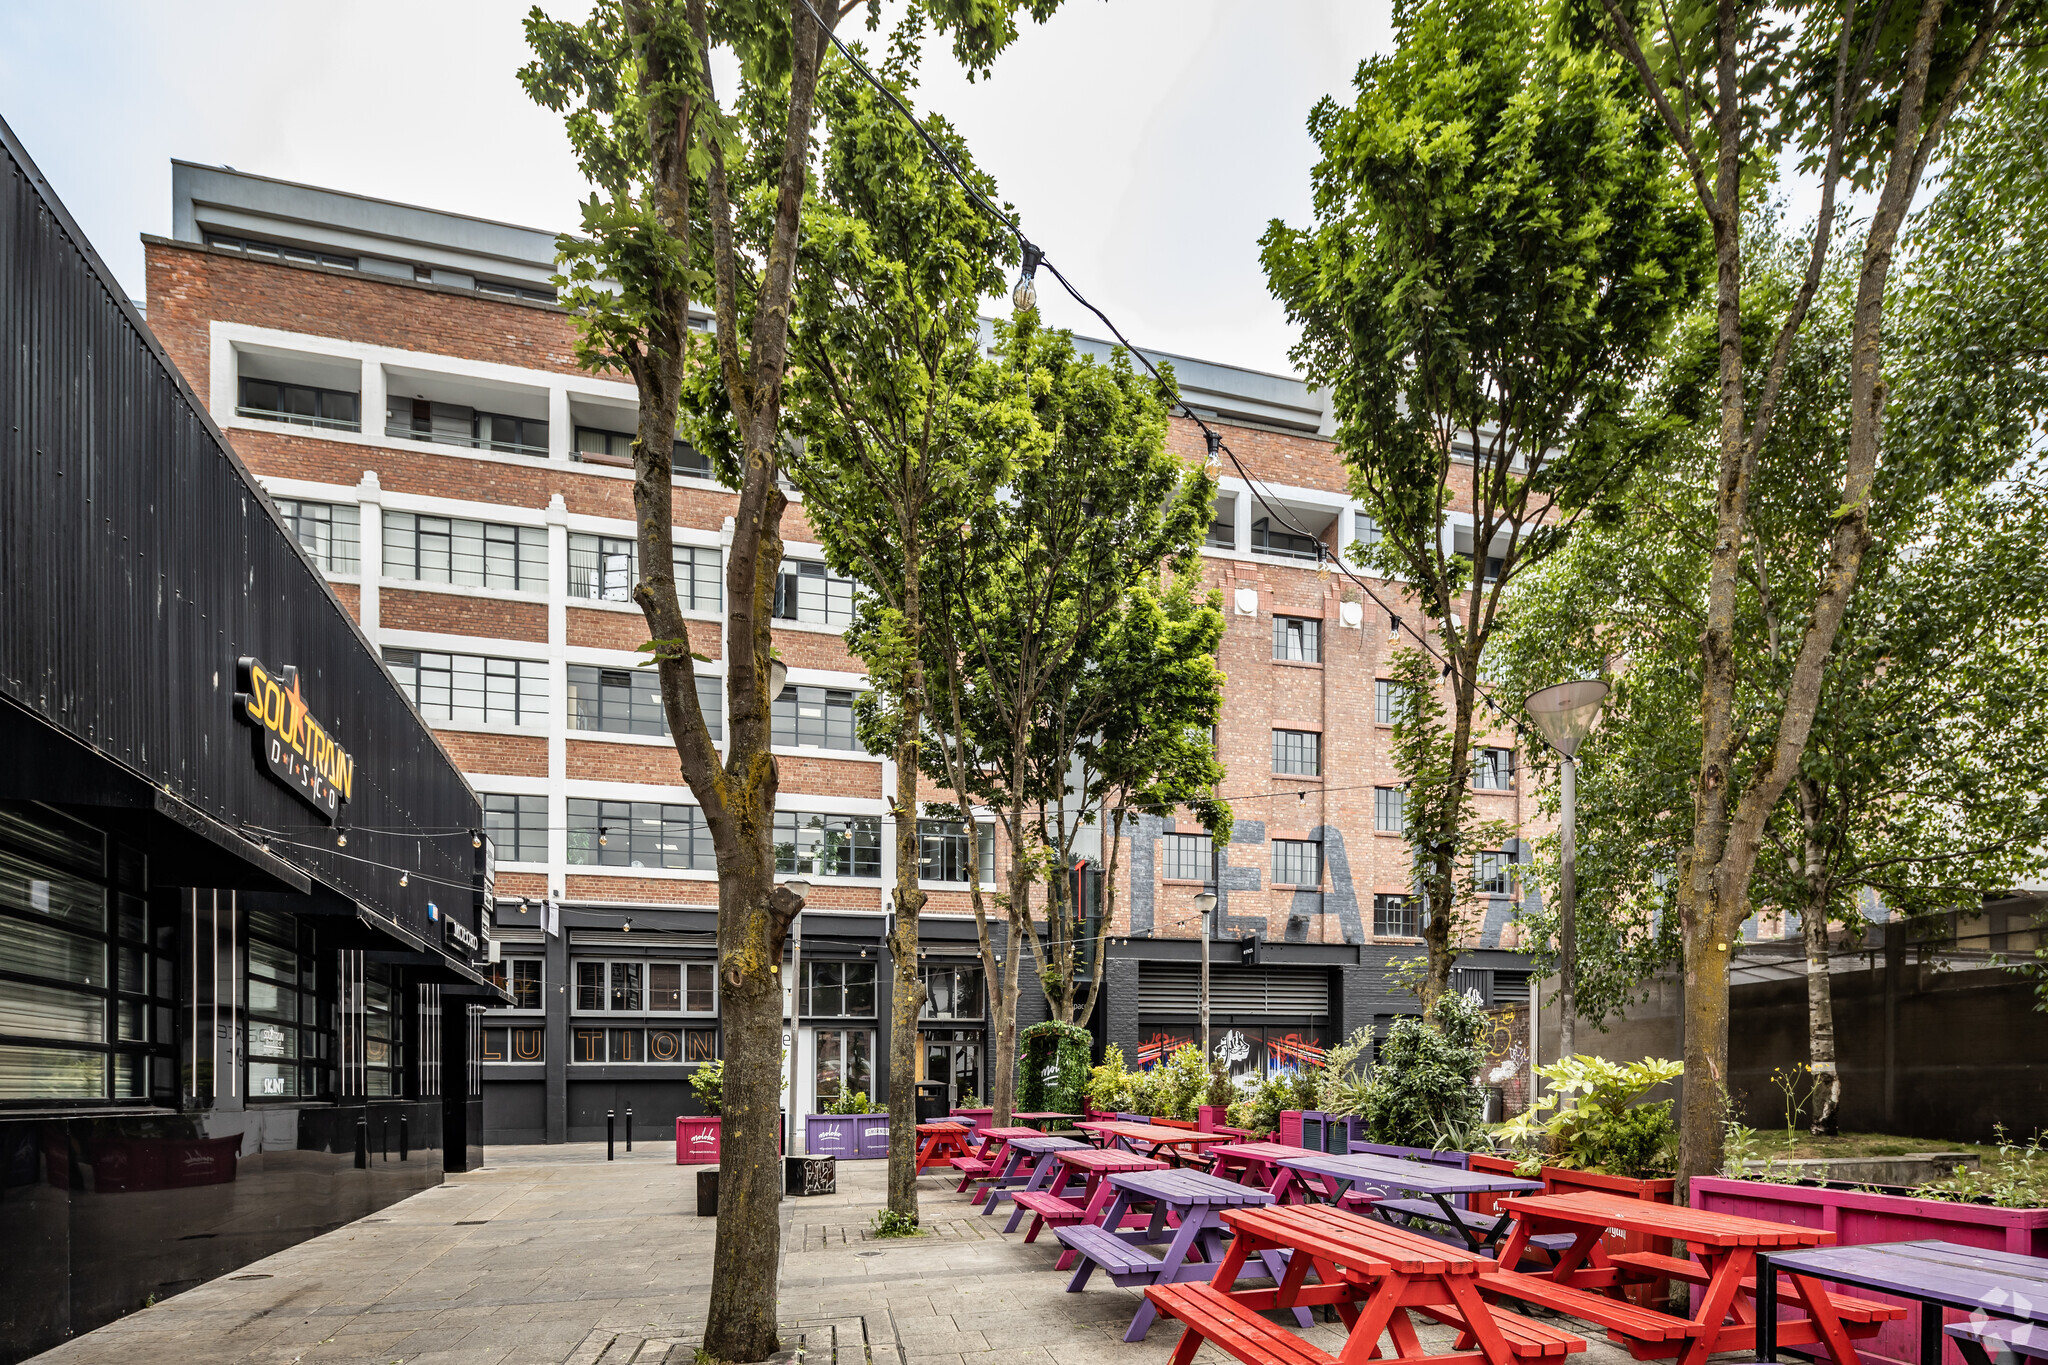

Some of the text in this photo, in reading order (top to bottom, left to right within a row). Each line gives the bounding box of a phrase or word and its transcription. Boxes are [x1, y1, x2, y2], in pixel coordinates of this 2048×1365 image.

[271, 738, 335, 810] DISCO
[1107, 810, 1365, 945] TEA
[690, 1126, 717, 1142] moloko
[818, 1123, 843, 1139] moloko
